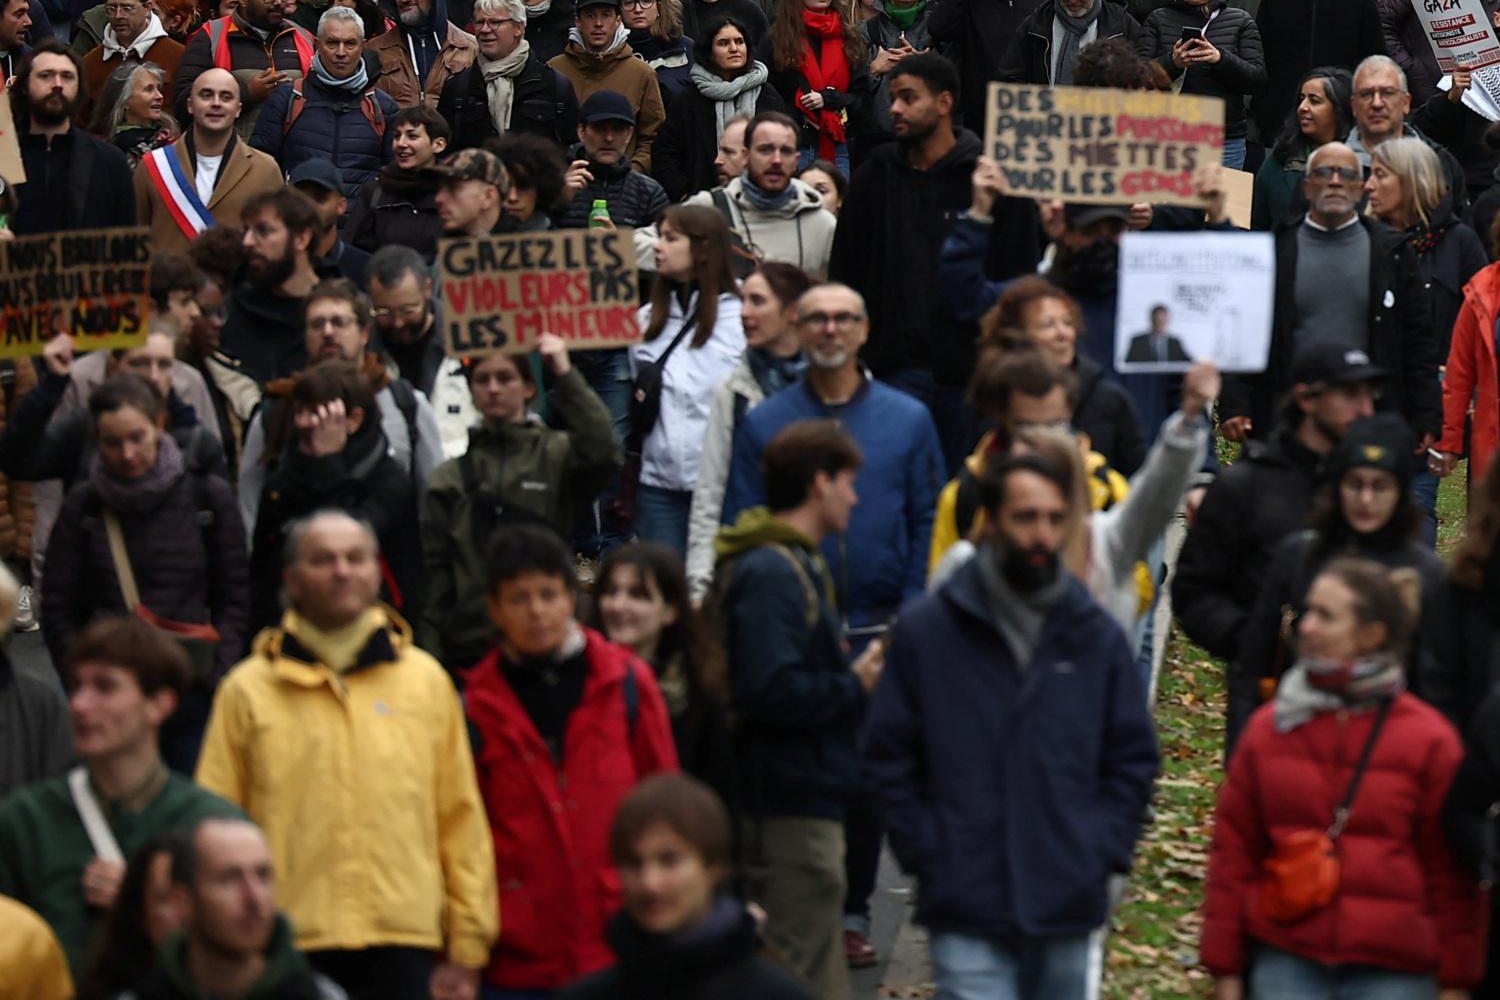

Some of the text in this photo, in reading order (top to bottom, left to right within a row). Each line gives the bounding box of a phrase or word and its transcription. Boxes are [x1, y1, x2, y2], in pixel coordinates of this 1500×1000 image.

[997, 88, 1055, 113] DES
[996, 115, 1064, 140] POUR
[1069, 116, 1113, 139] LES
[993, 140, 1200, 171] DES MIETTES
[1061, 169, 1116, 195] LES
[1120, 170, 1196, 198] GENS
[443, 234, 623, 276] GAZEZ LES
[445, 266, 635, 316] VIOLEURS PAS
[6, 299, 143, 347] AVEC NOUS
[451, 304, 642, 352] LES MINEURS
